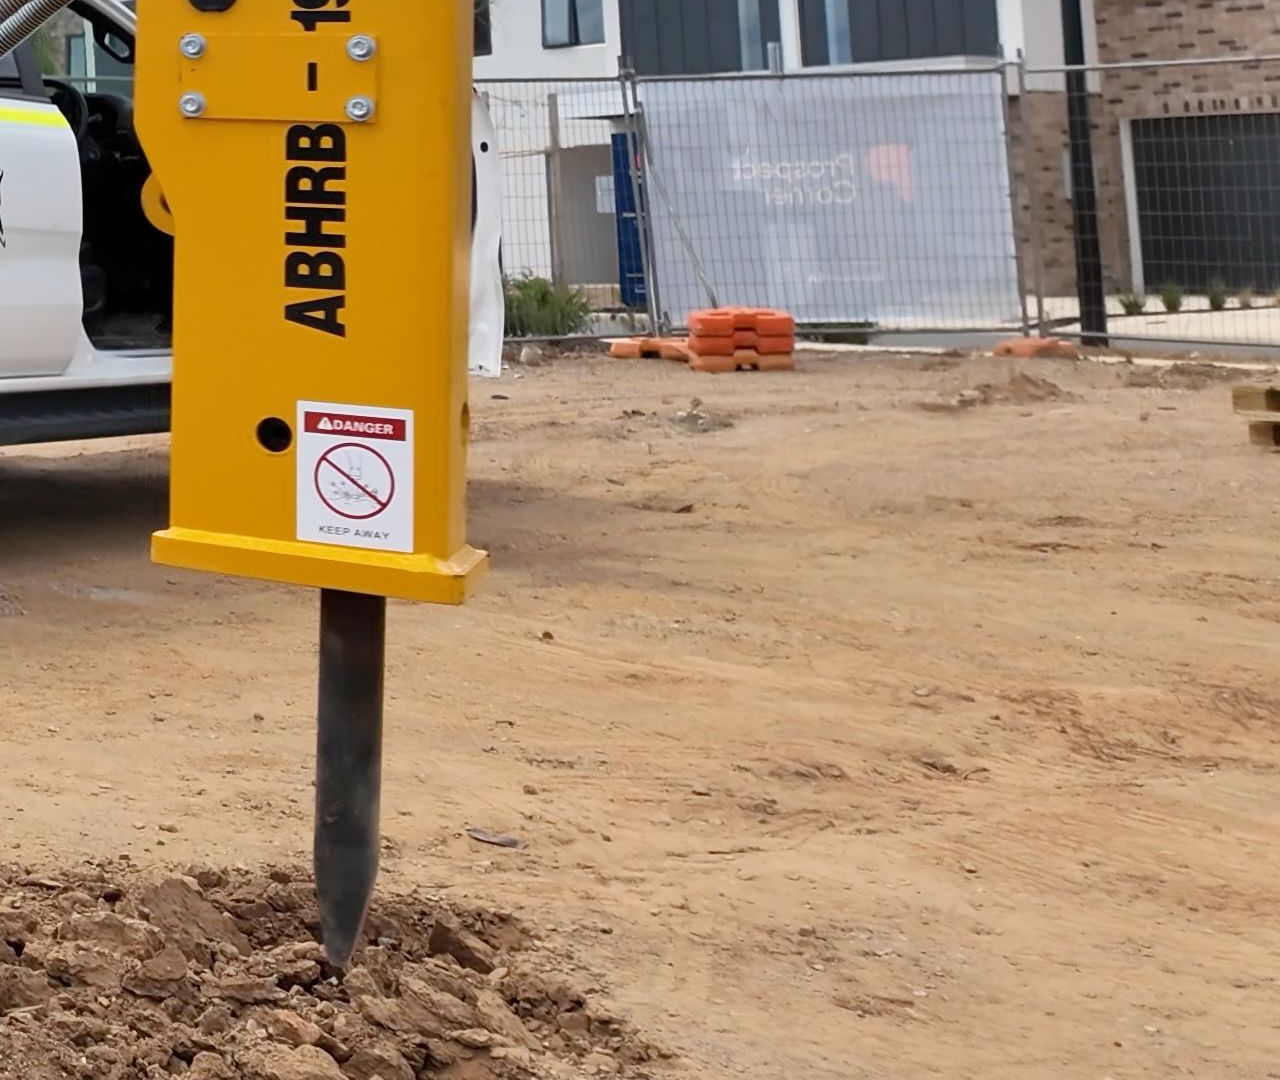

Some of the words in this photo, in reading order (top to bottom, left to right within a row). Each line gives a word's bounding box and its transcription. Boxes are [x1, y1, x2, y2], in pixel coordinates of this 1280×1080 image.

[284, 123, 346, 338] ABHRB
[332, 419, 394, 435] DANGER
[319, 524, 350, 536] KEEP
[354, 528, 390, 540] AWAY
